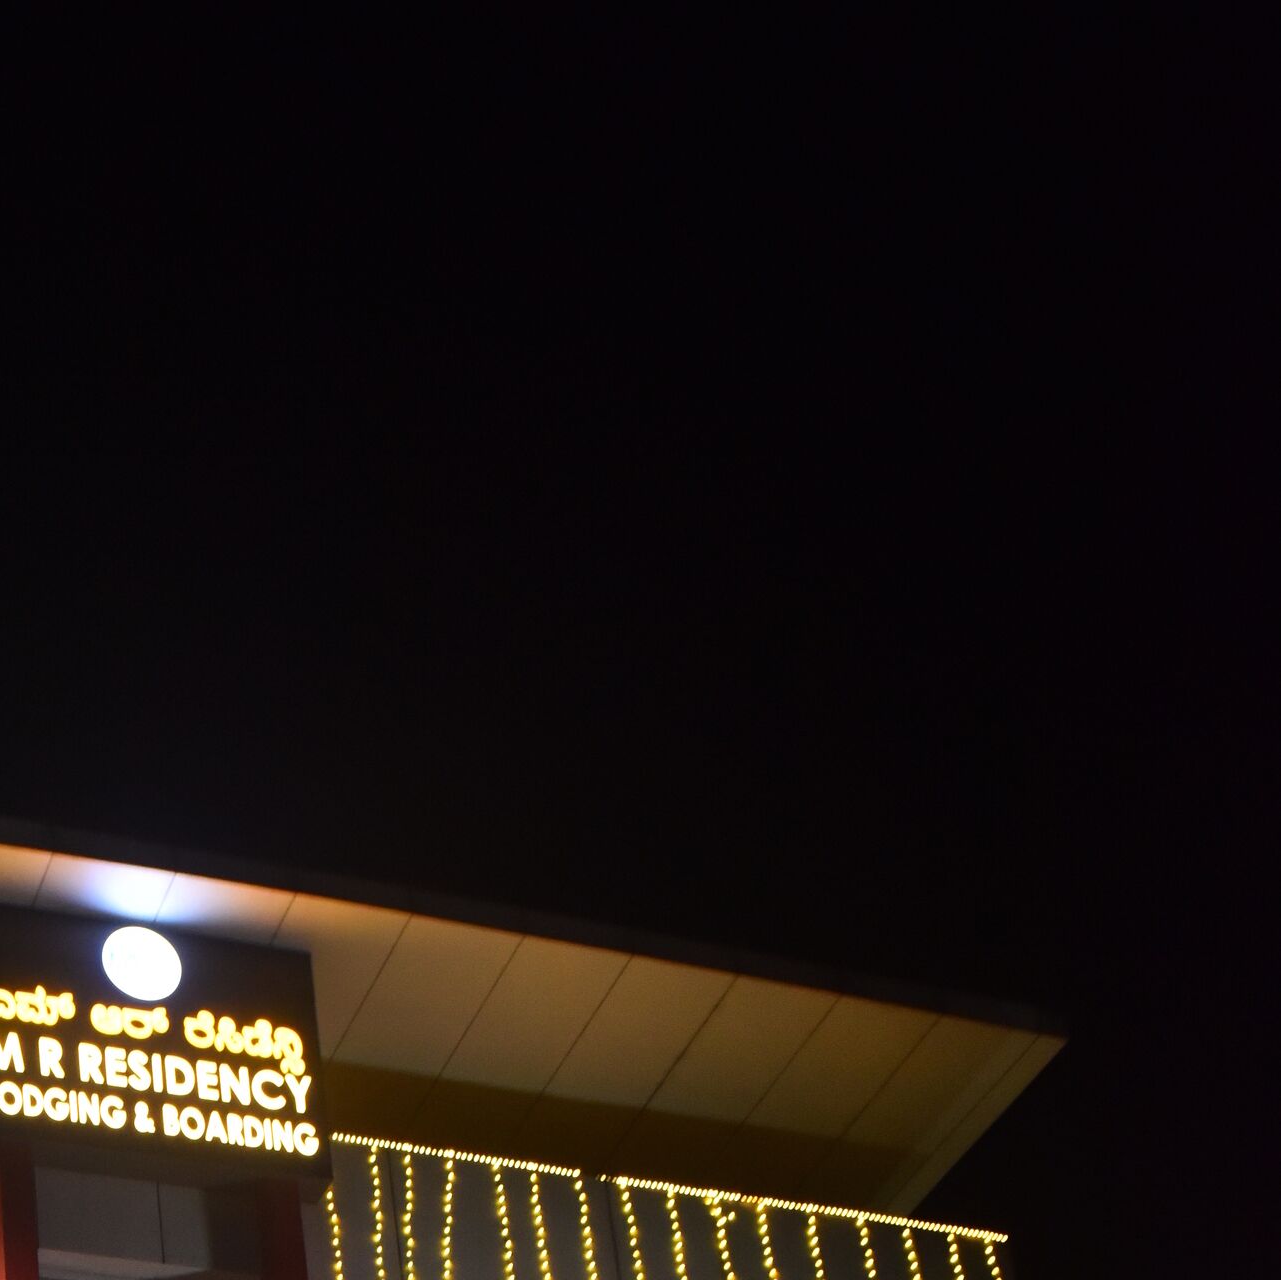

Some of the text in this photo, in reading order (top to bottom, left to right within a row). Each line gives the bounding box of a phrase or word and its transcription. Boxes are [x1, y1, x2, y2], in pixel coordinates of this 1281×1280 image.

[38, 1036, 65, 1078] R
[77, 1042, 311, 1114] RESIDENCY
[134, 1103, 156, 1134] &
[162, 1104, 319, 1157] BOARDING
